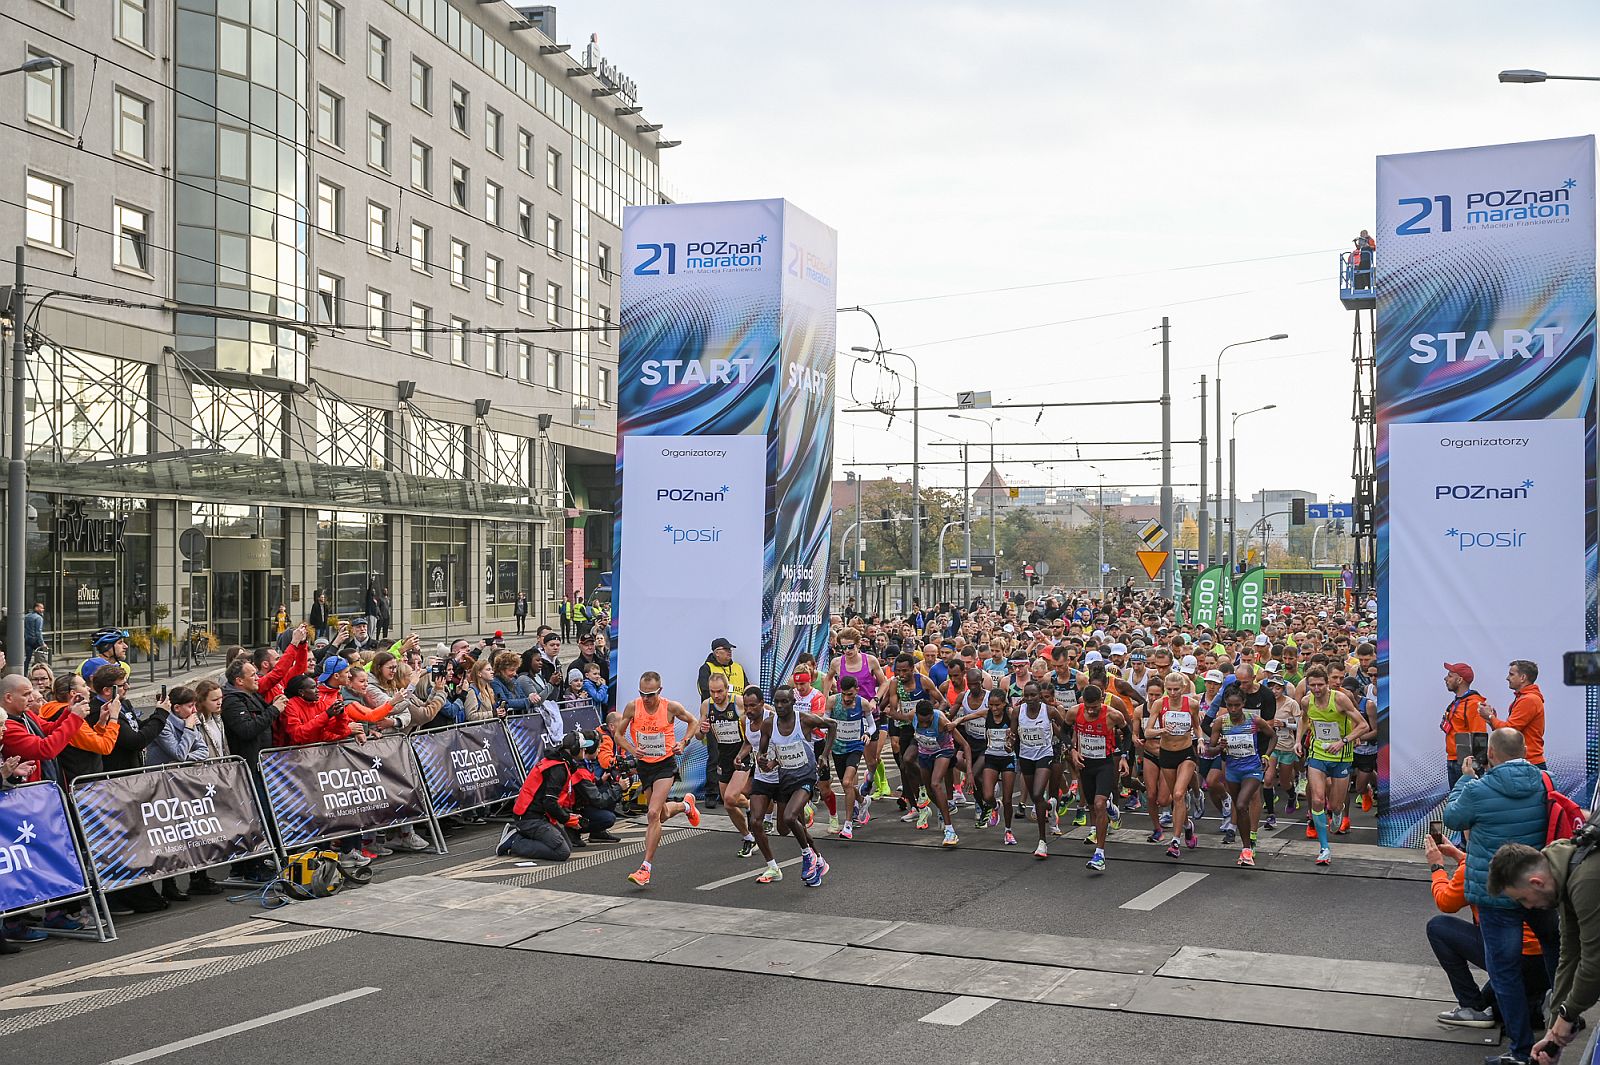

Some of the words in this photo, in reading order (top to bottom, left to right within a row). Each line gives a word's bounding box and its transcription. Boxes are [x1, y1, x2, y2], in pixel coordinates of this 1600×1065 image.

[1395, 195, 1452, 236] 21
[1467, 203, 1570, 224] maraton
[633, 242, 676, 276] 21
[687, 253, 762, 268] maraton
[1408, 326, 1564, 364] START
[639, 358, 754, 385] START
[789, 362, 829, 396] START
[960, 392, 971, 404] Z
[661, 448, 727, 459] Organizatorzy
[1440, 437, 1530, 449] Organizatorzy
[56, 505, 127, 552] RYNEK
[781, 563, 796, 583] Mój
[77, 586, 100, 601] RYNEK
[1197, 579, 1215, 621] 3:00
[1241, 582, 1258, 625] 3:00
[455, 763, 498, 785] maraton
[323, 784, 388, 810] maraton
[147, 815, 224, 847] maraton
